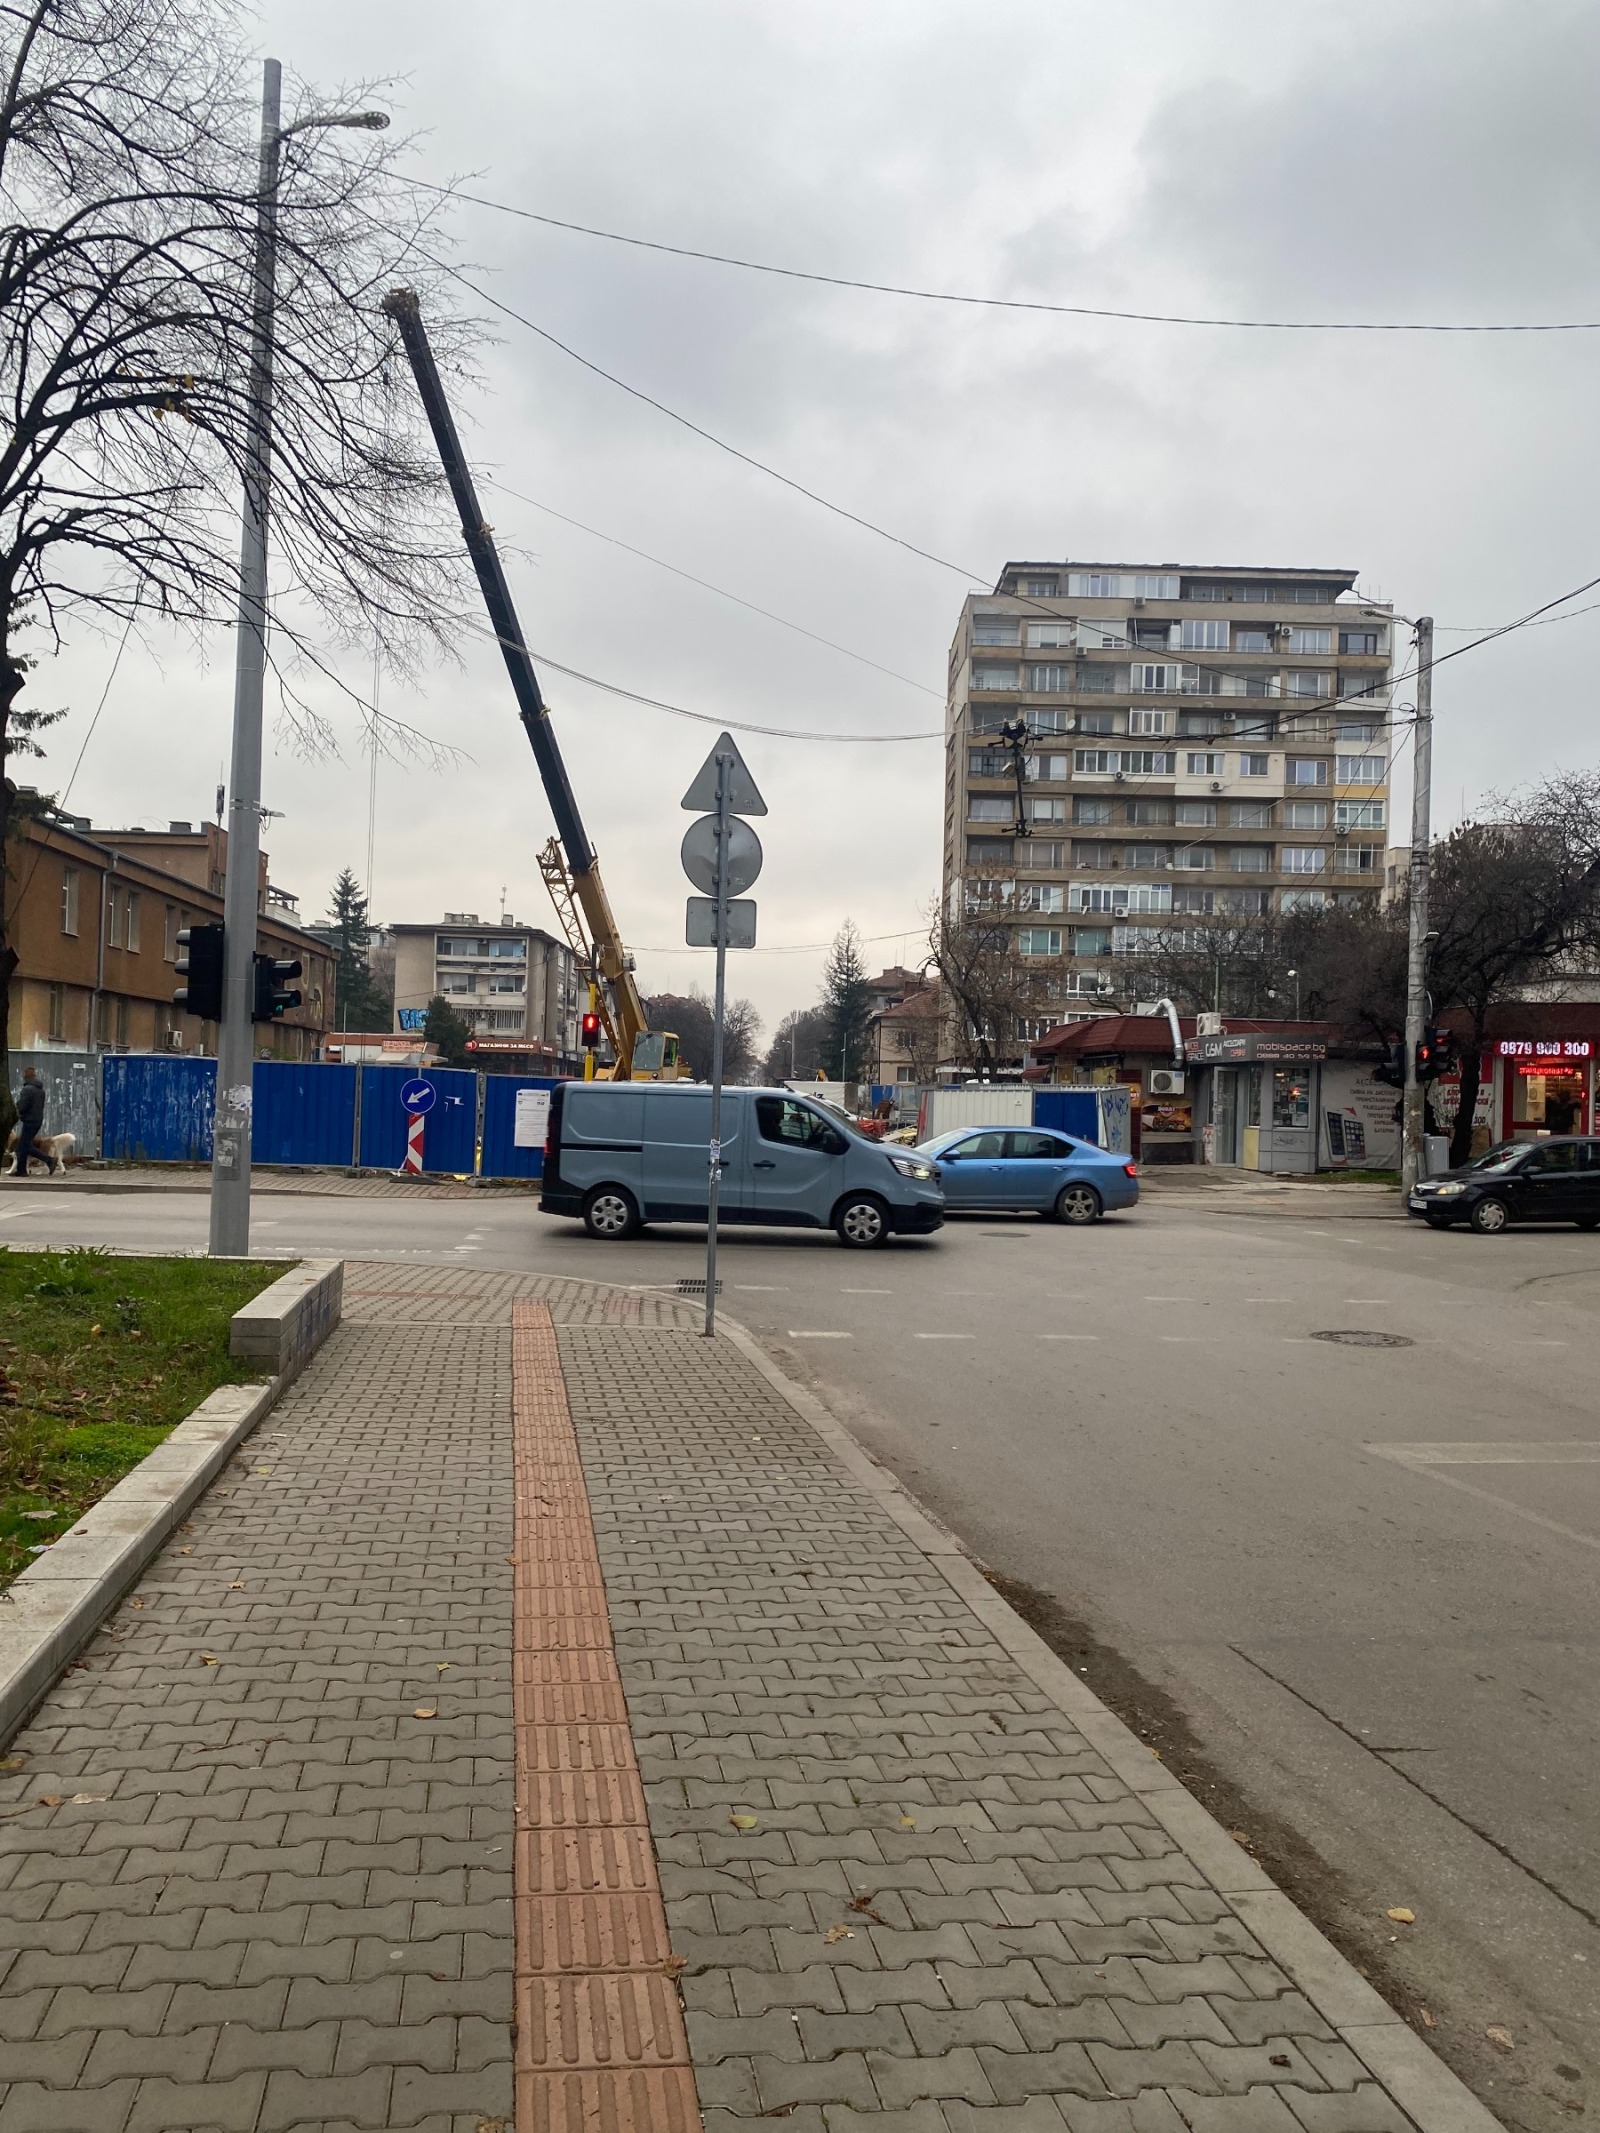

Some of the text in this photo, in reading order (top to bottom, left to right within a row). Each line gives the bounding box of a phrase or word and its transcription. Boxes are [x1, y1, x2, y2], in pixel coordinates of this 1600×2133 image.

[1256, 1042, 1326, 1053] mobispace.bg
[1500, 1041, 1590, 1056] 0879 900 300
